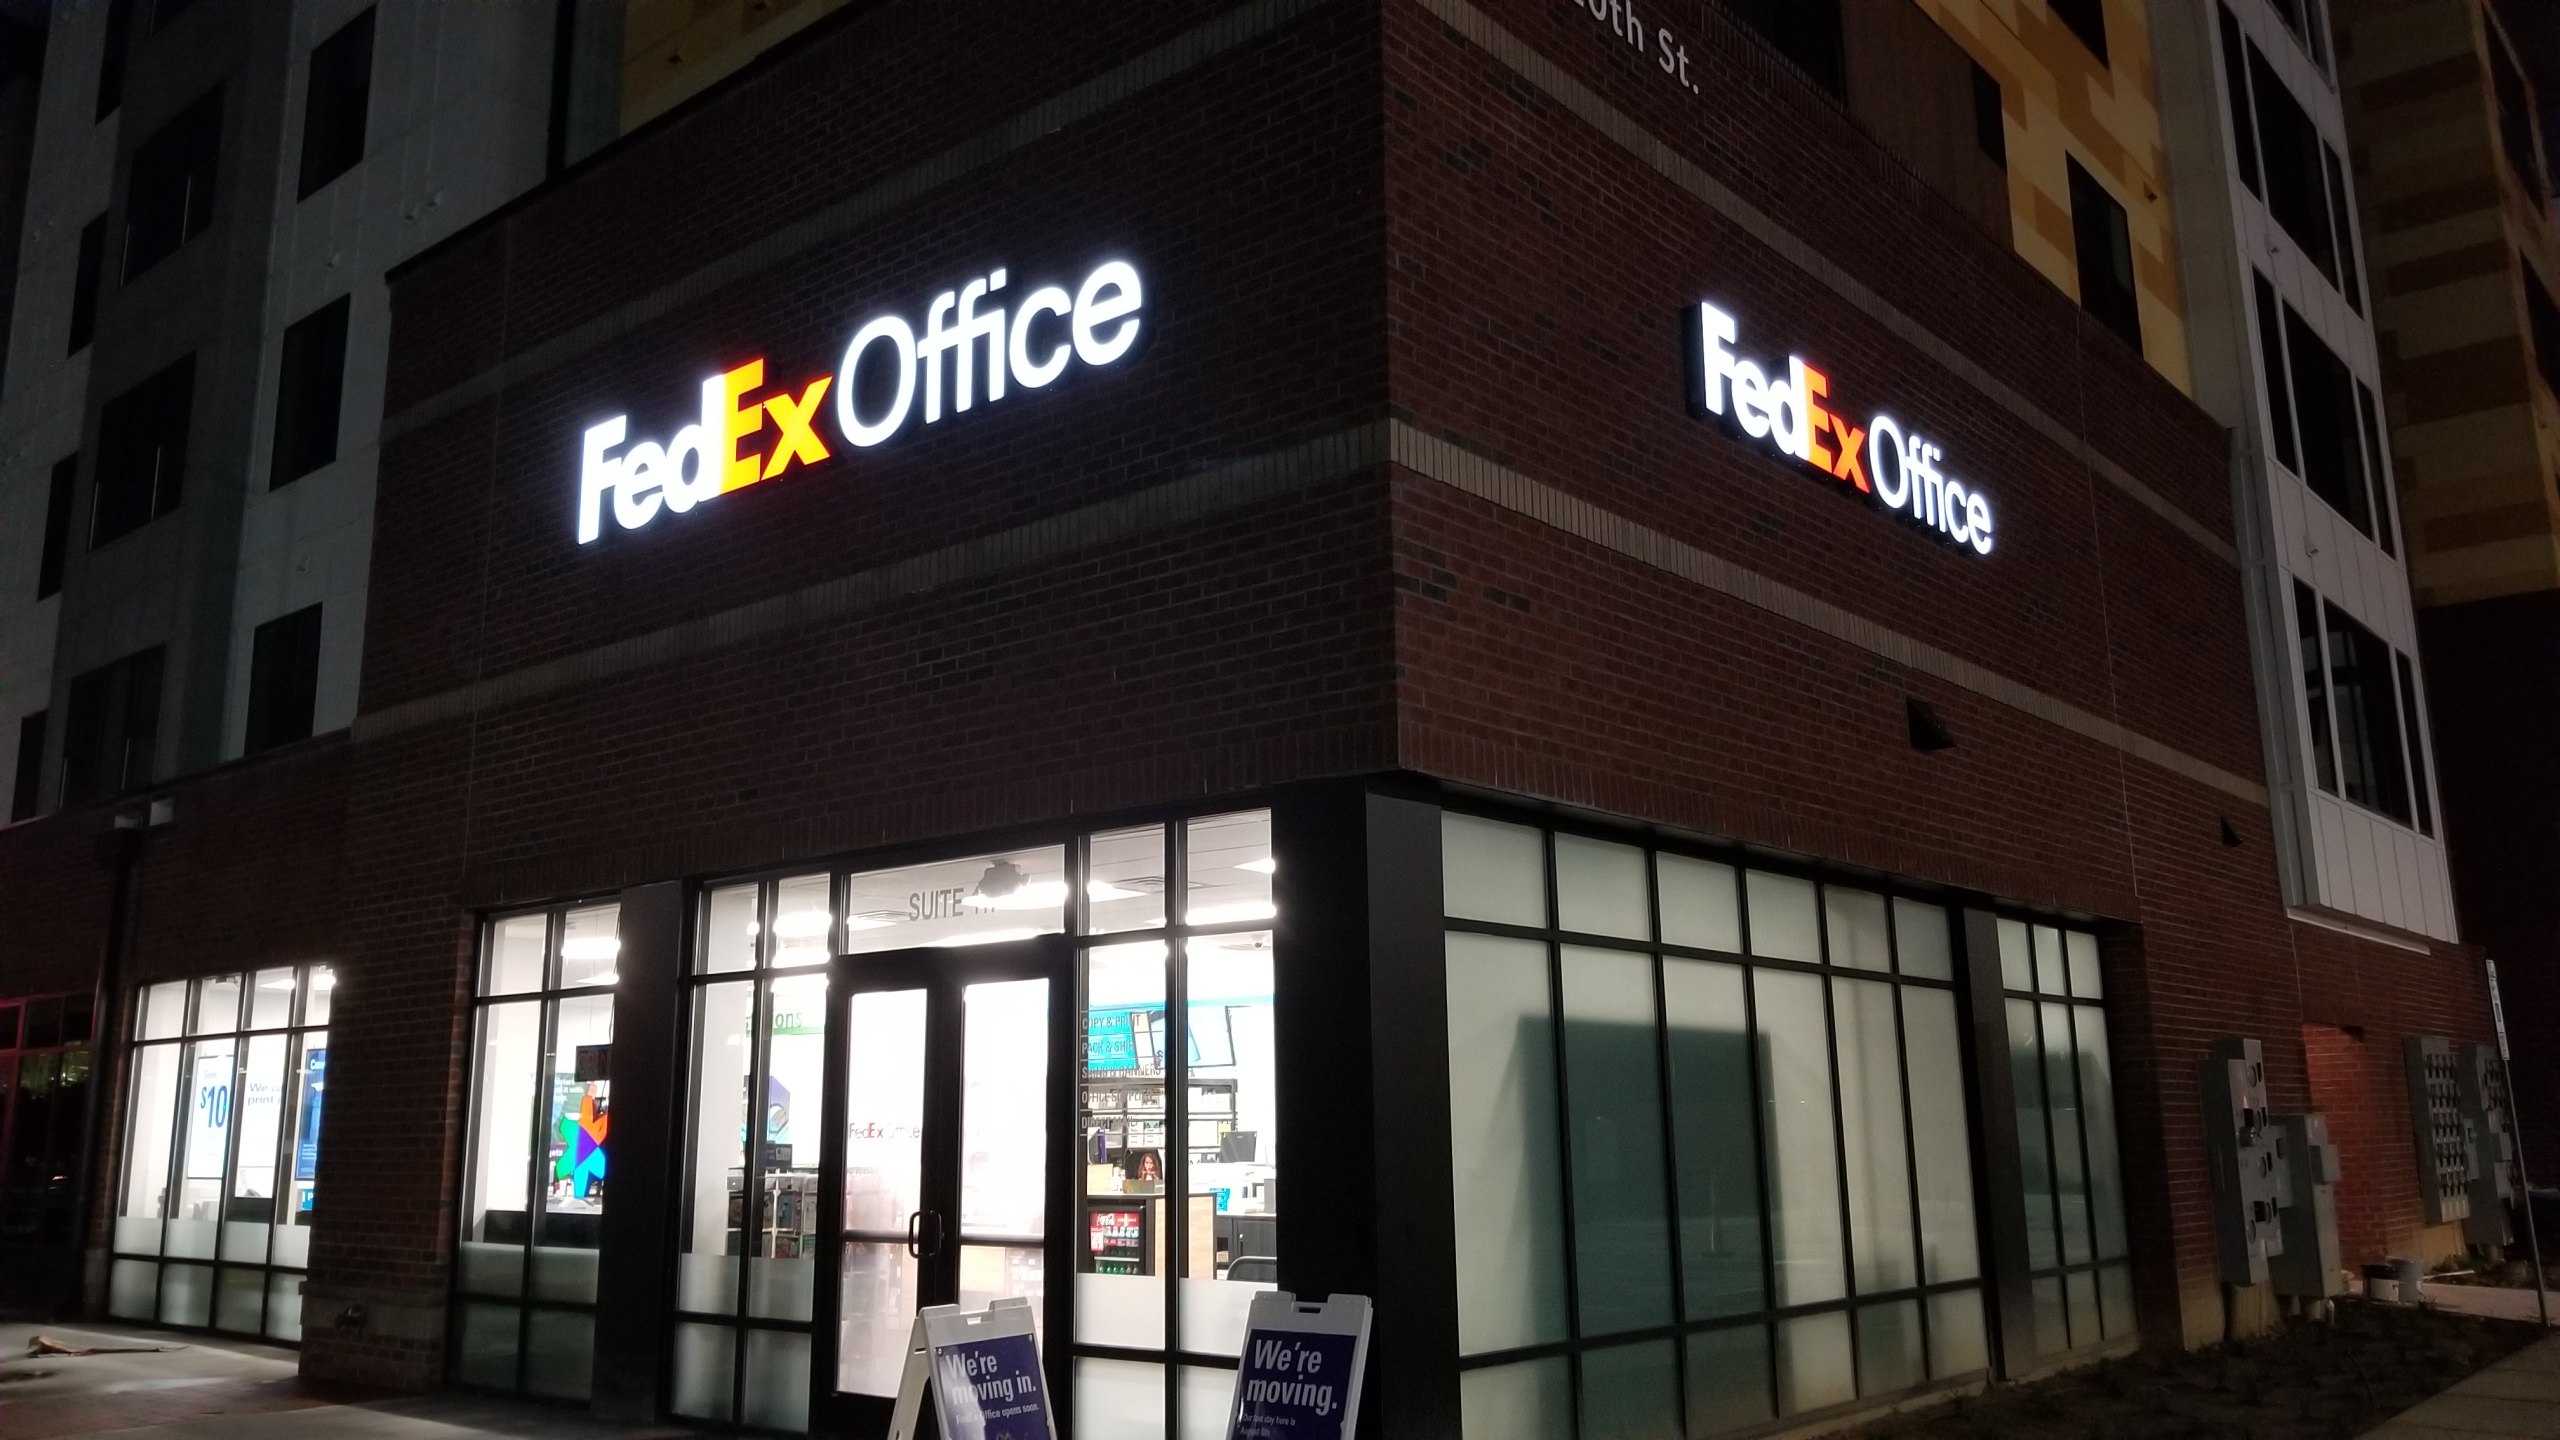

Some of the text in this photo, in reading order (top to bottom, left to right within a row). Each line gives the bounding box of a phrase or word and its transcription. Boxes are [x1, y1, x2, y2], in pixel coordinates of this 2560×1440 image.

[1658, 28, 1699, 95] St.
[578, 260, 1143, 546] FedEx Office
[1700, 300, 1993, 555] FedEx Office
[908, 887, 964, 921] SUITE
[1115, 1014, 1141, 1028] PRIT
[1082, 1042, 1104, 1055] PACK
[249, 1083, 268, 1093] We
[1119, 1064, 1162, 1078] BANNERS
[200, 1084, 228, 1129] $10
[945, 1350, 998, 1380] We're
[1254, 1339, 1322, 1374] We're
[951, 1370, 1037, 1406] moving in.
[1246, 1374, 1338, 1416] moving.
